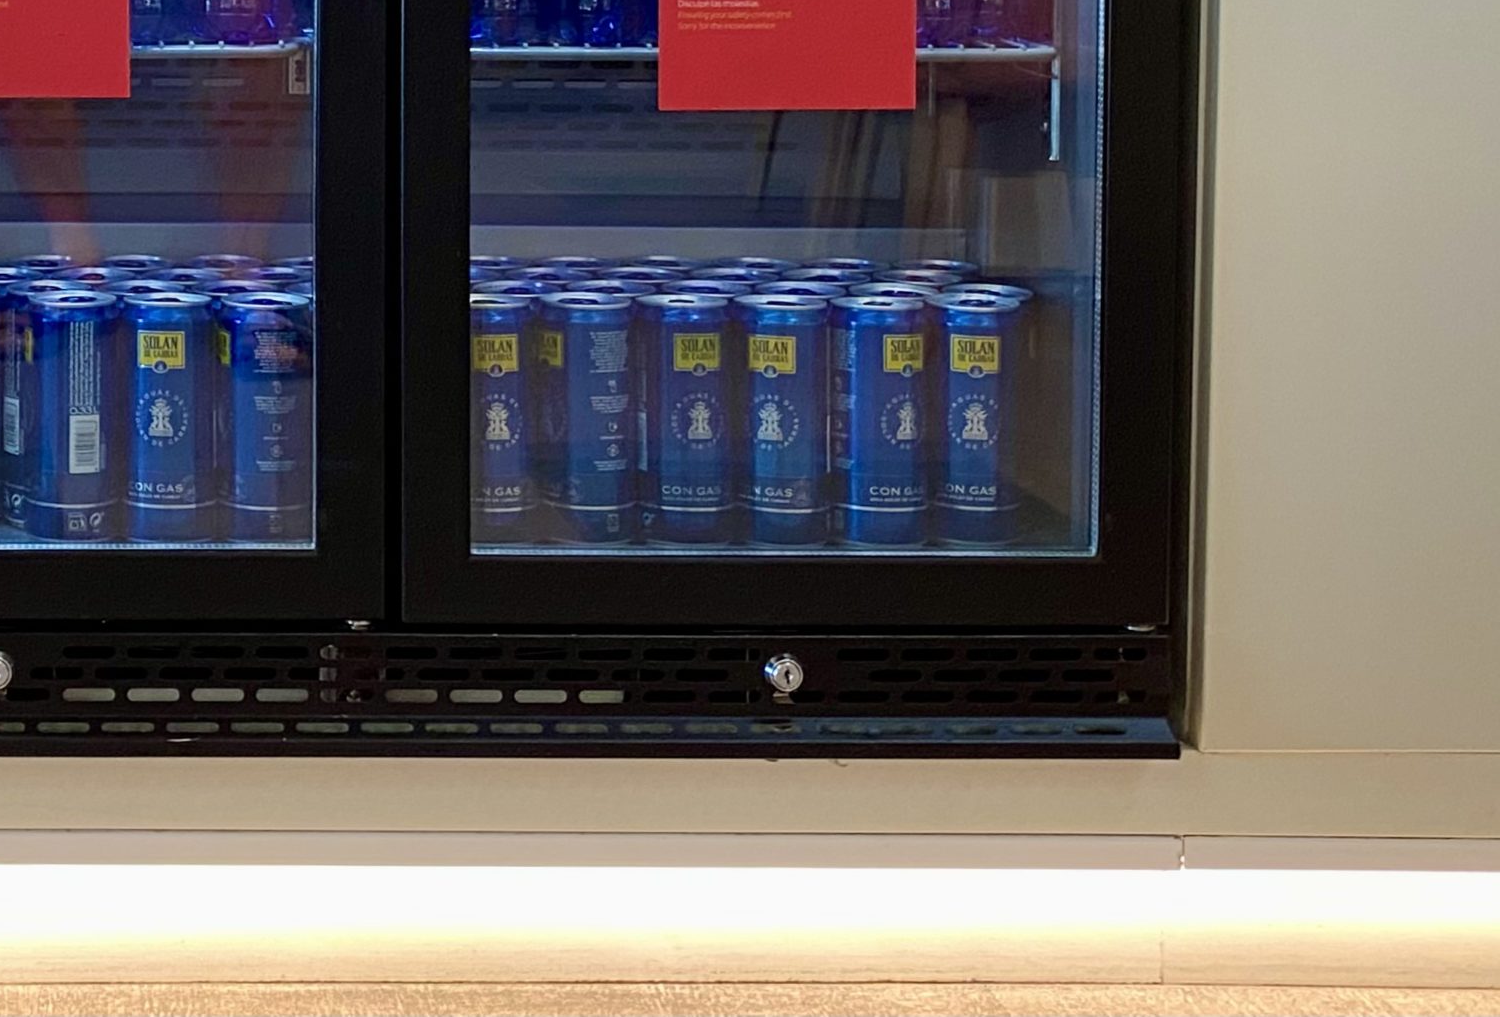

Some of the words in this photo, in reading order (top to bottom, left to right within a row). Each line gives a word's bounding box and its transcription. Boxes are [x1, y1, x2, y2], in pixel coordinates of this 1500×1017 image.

[143, 335, 178, 349] SOLAN
[477, 339, 513, 353] SOLAN
[681, 338, 716, 352] SOLAN
[752, 339, 789, 355] SOLAN
[957, 339, 995, 355] SOLAN
[156, 483, 184, 493] GAS
[494, 486, 521, 496] GAS
[661, 485, 693, 495] CON
[764, 487, 793, 498] GAS
[869, 486, 901, 496] CON
[969, 485, 997, 496] GAS
